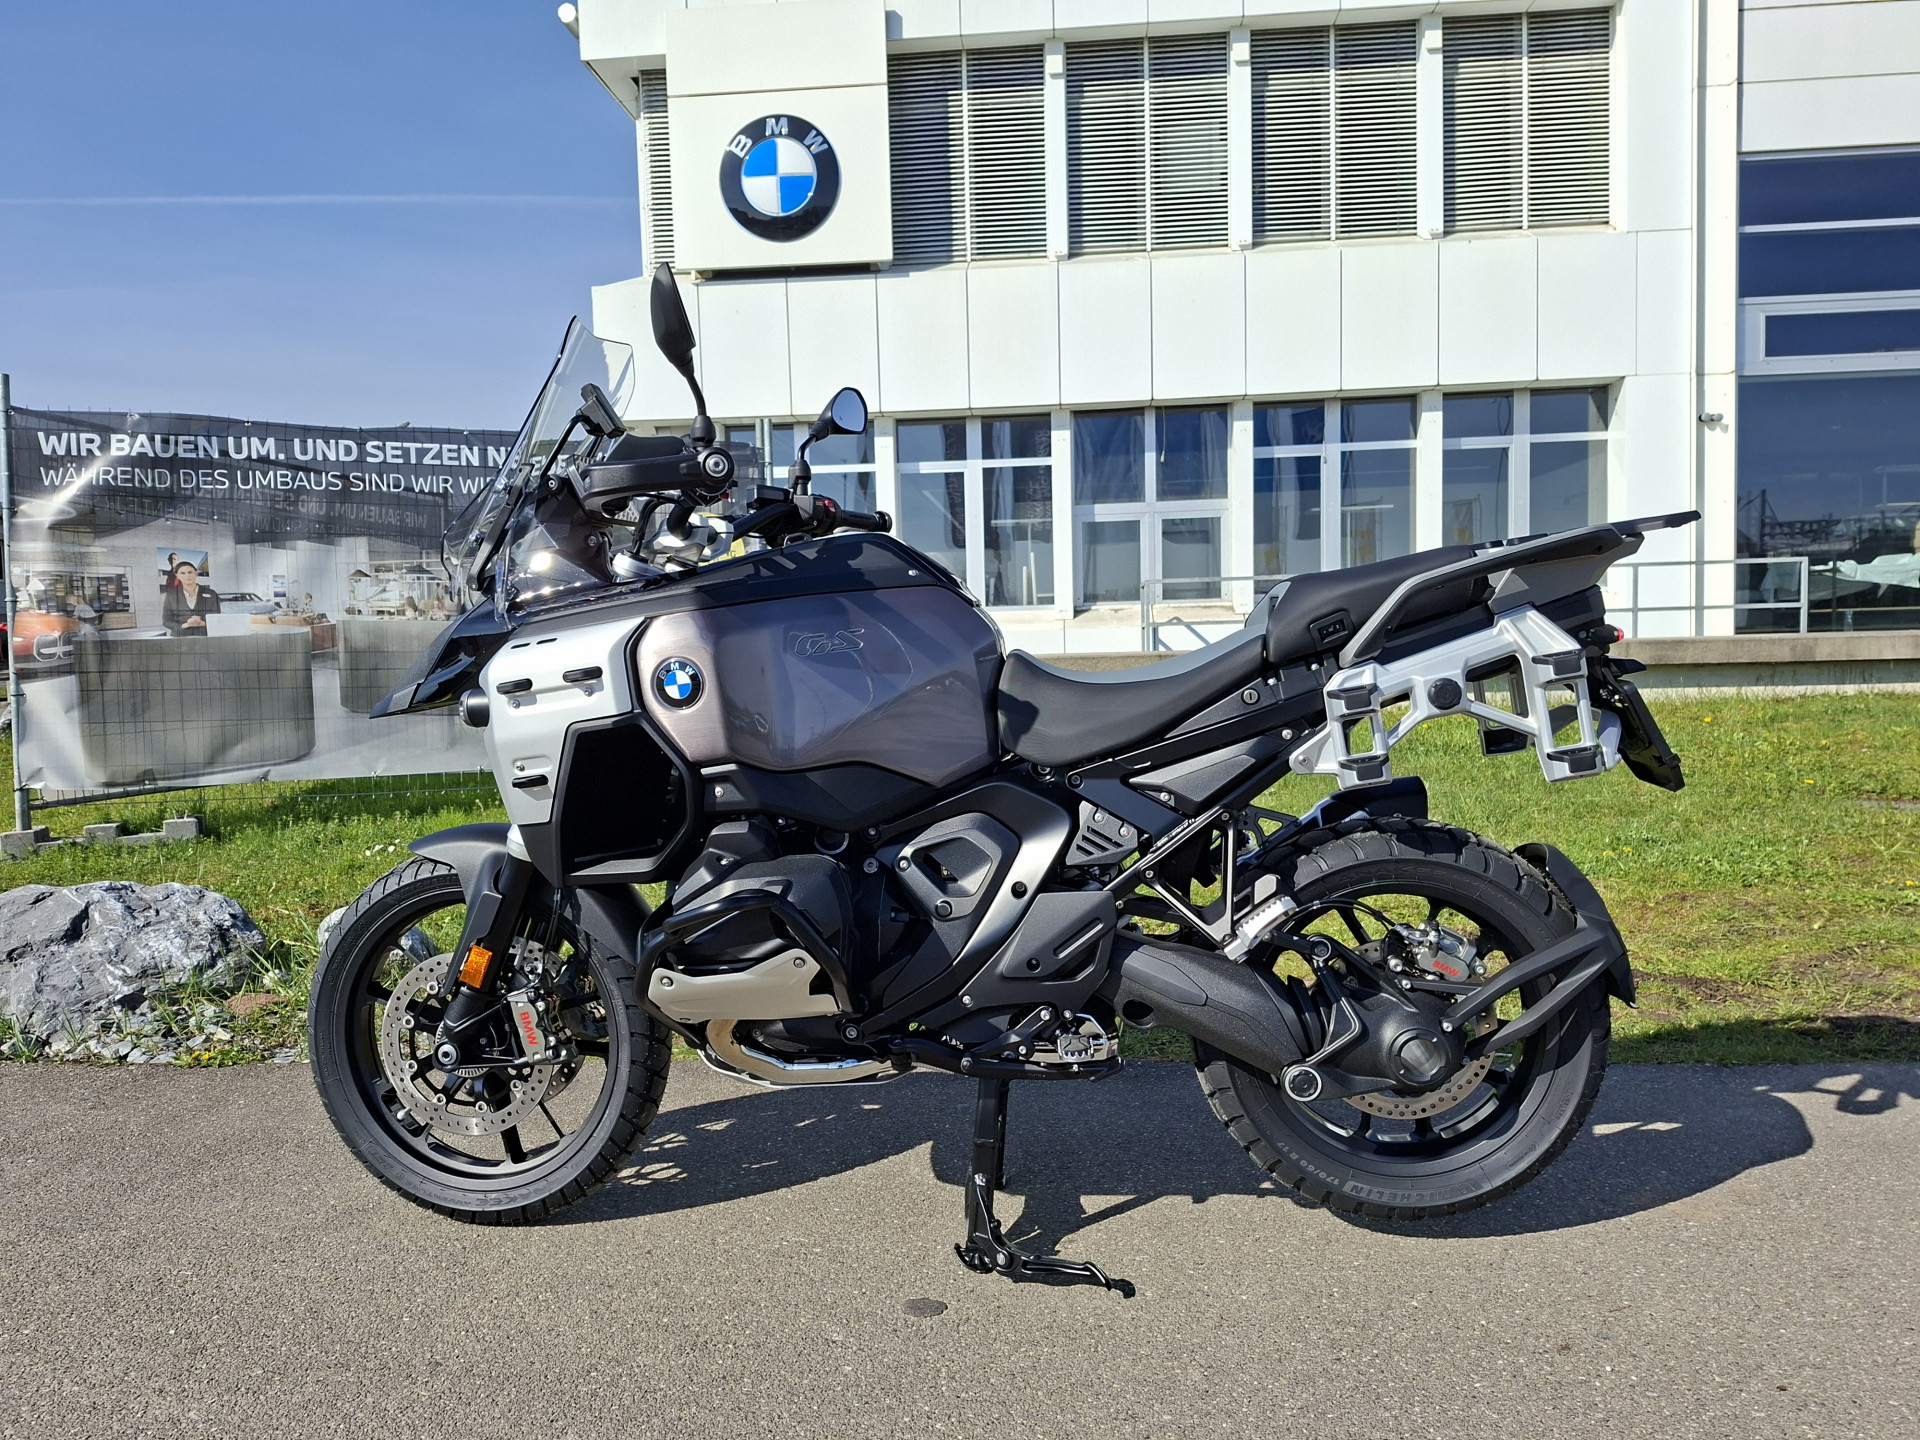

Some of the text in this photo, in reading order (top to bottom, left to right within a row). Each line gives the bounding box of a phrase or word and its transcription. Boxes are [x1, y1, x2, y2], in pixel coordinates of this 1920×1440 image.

[726, 116, 829, 158] BMW
[37, 431, 102, 457] WIR
[110, 433, 219, 459] BAUEN
[228, 436, 285, 461] UM.
[293, 439, 358, 463] UND
[365, 441, 480, 468] SETZEN
[39, 462, 171, 489] WÄHREND
[180, 469, 230, 489] DES
[237, 470, 342, 491] UMBAUS
[350, 473, 405, 493] SIND
[412, 474, 454, 494] WIR
[659, 662, 695, 679] BMW
[1432, 960, 1460, 977] BMW
[519, 1011, 538, 1045] BMW
[1299, 1159, 1340, 1185] 170/60
